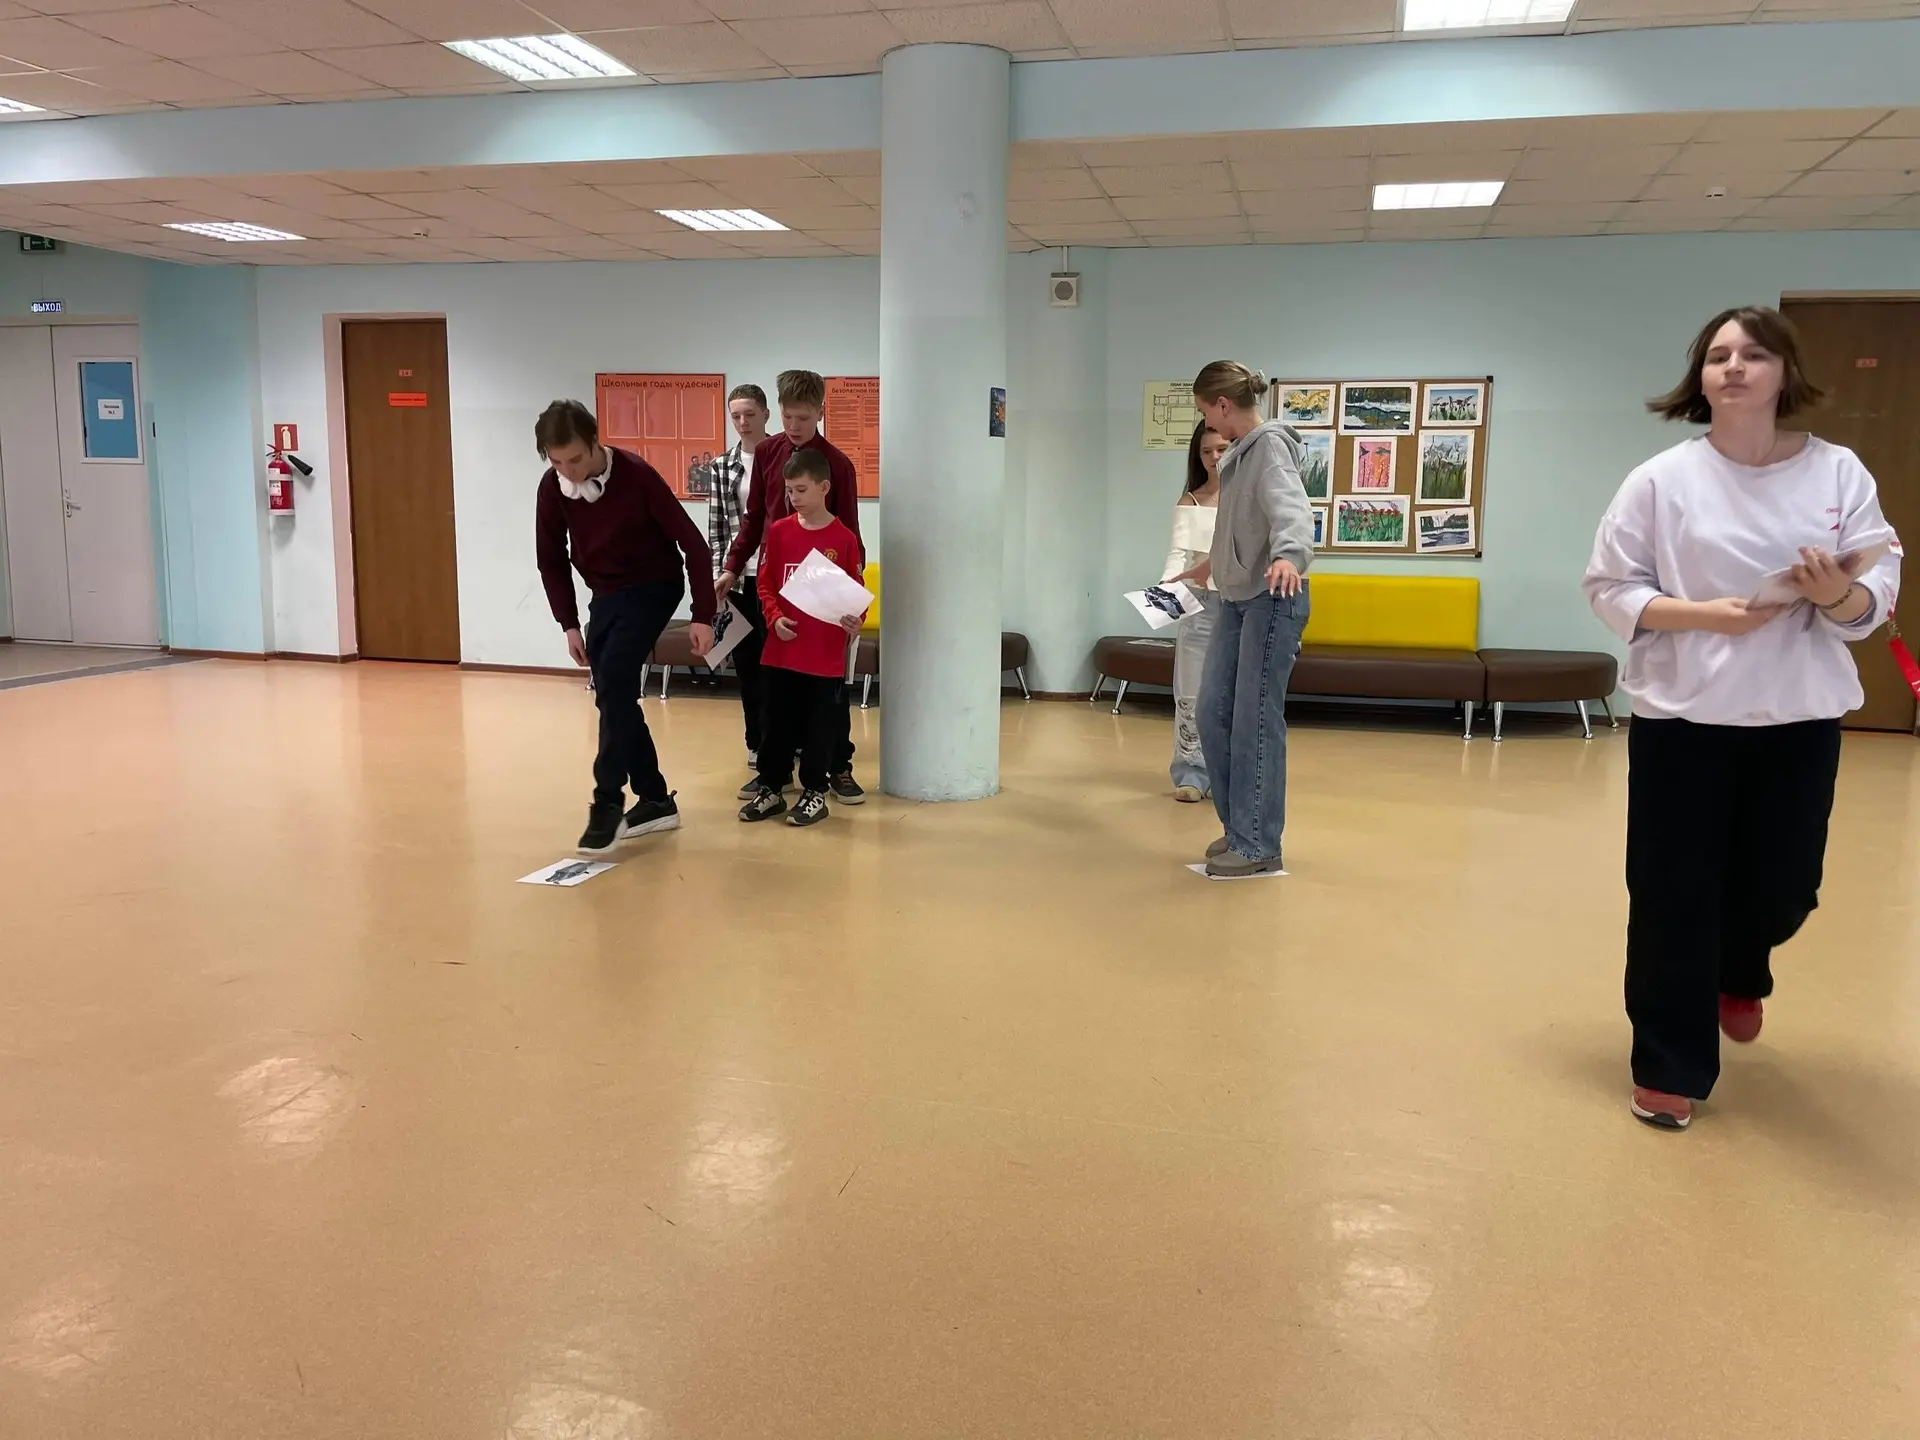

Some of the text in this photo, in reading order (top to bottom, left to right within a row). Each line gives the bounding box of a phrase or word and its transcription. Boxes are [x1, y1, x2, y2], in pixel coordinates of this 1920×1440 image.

[33, 302, 62, 313] ВЫХОД
[601, 378, 721, 390] Школьные годы чудесные!
